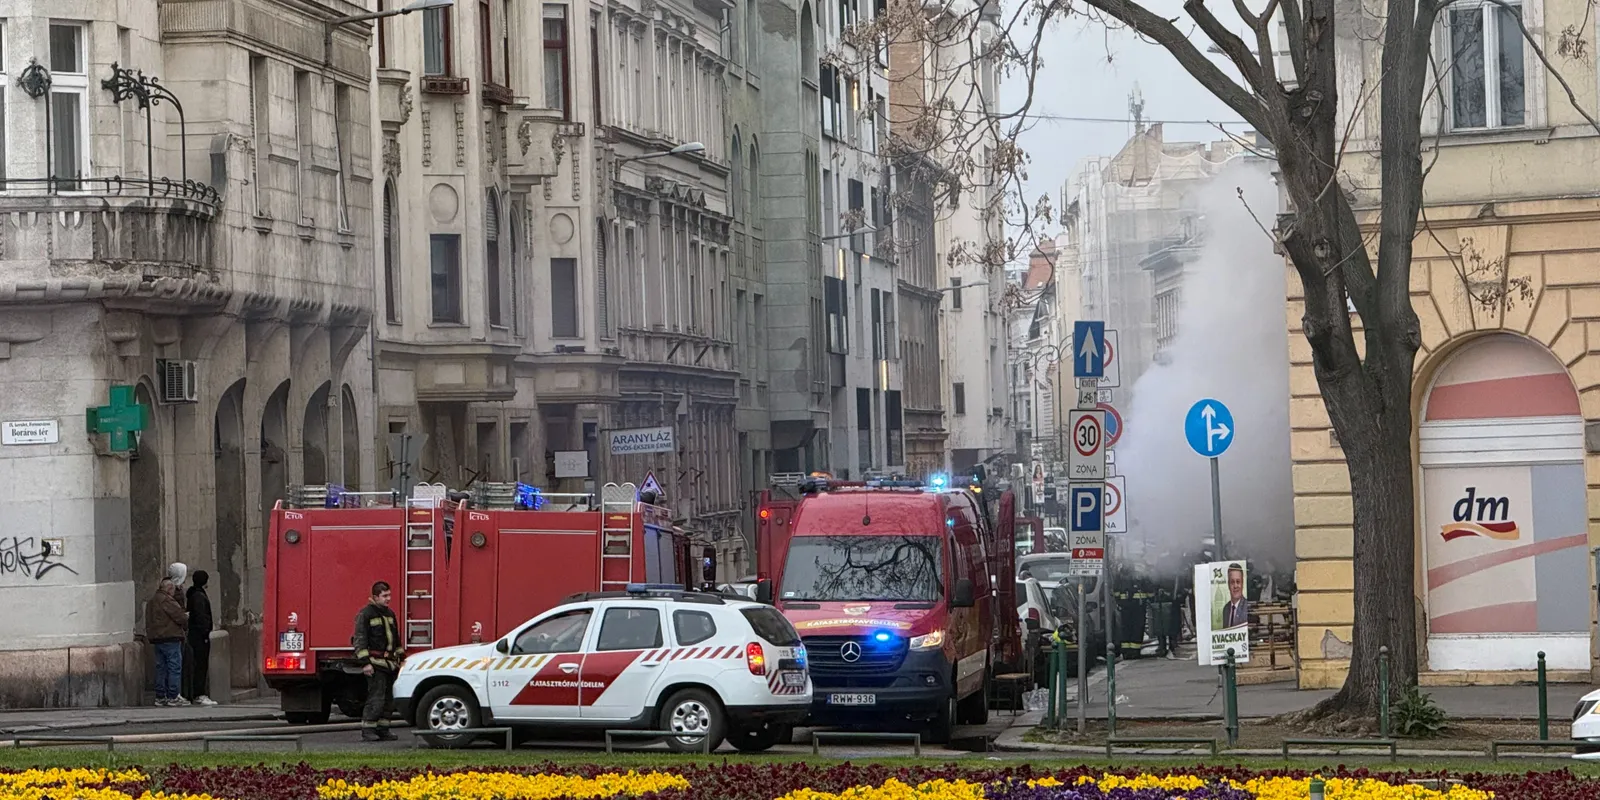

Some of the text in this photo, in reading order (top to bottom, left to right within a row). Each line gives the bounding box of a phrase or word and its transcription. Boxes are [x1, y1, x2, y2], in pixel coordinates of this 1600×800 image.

[12, 428, 37, 436] Boráros
[1079, 425, 1096, 446] 30
[613, 431, 671, 444] ARANYLÁZ
[1076, 464, 1097, 473] ZÓNA
[1453, 487, 1509, 522] dm
[1077, 492, 1096, 527] P
[1076, 535, 1097, 545] ZÓNA
[807, 619, 900, 627] KATASZTRÓFAVÉDELEM
[1212, 632, 1246, 644] KVACSKAY
[286, 642, 302, 650] 559
[530, 679, 605, 688] KATASZTRÓFAVÉDELEM
[833, 694, 874, 703] RWW-936
